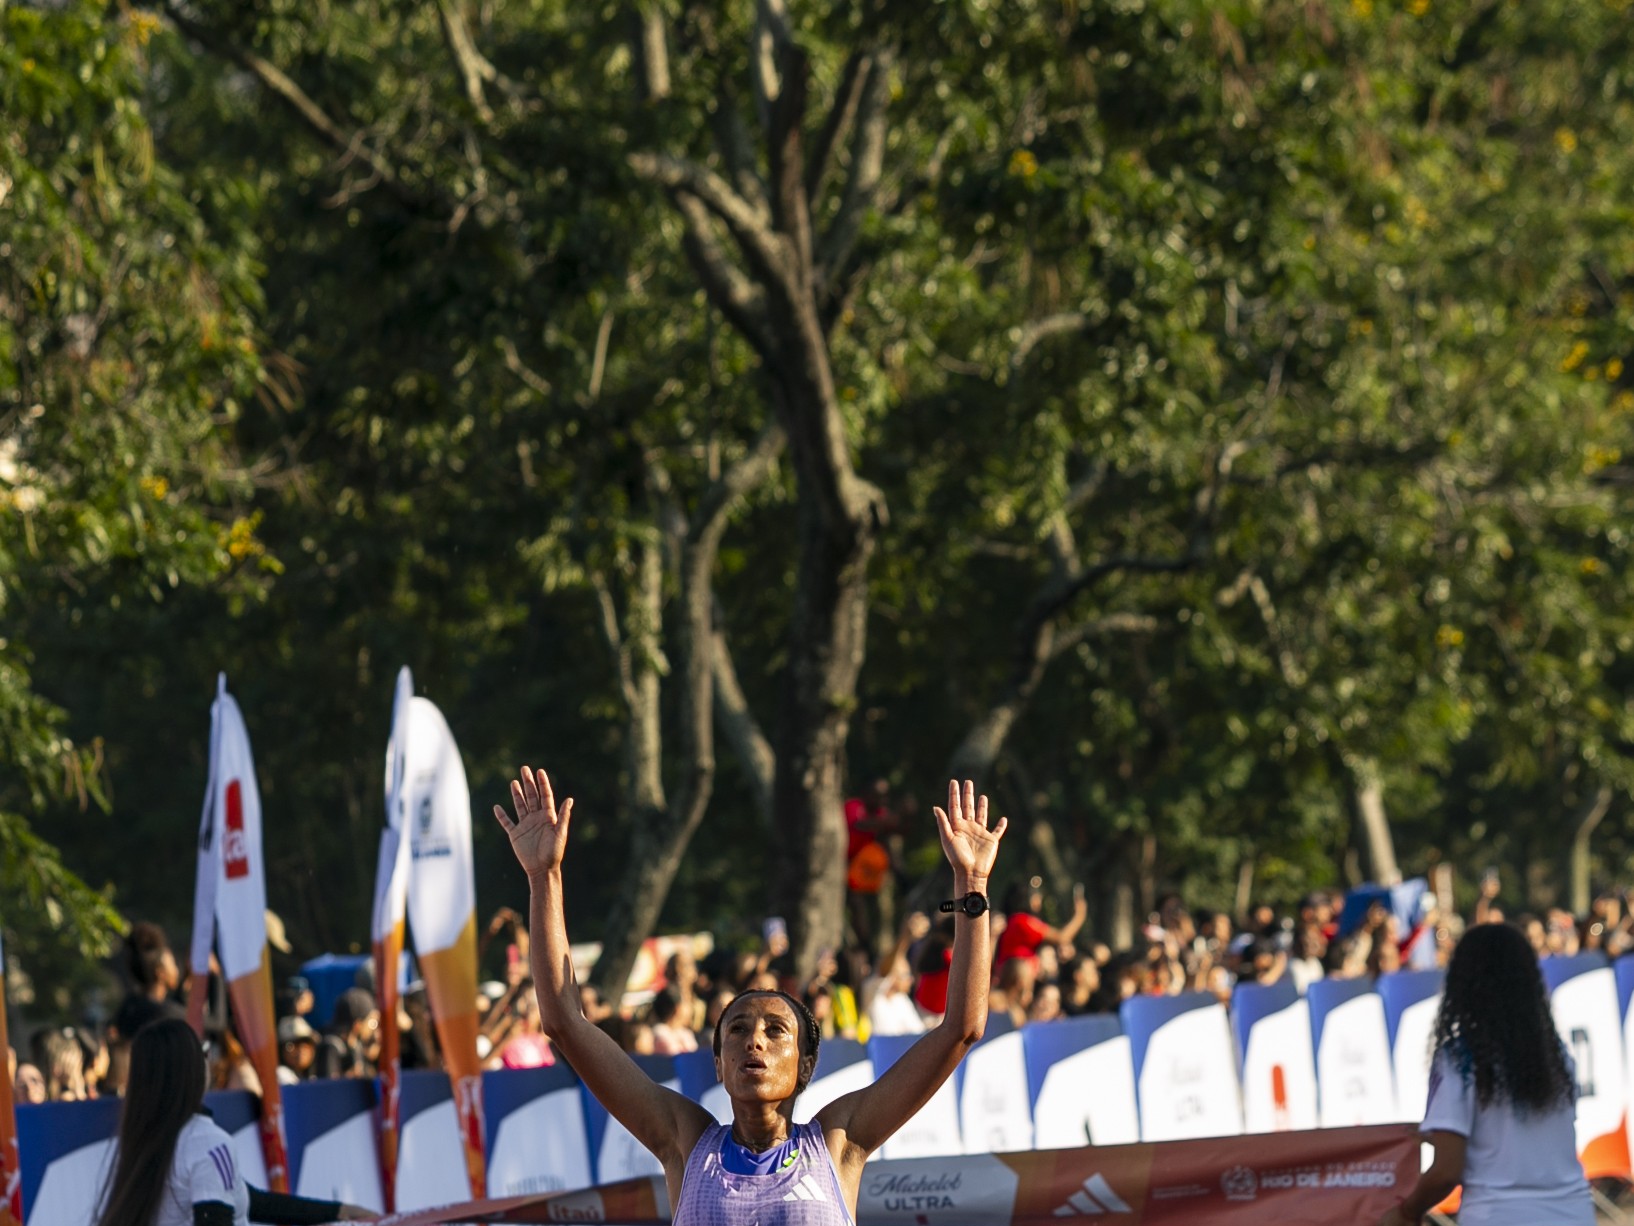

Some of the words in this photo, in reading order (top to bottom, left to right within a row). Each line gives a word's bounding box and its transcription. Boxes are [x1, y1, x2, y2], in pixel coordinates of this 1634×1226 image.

[868, 1172, 963, 1198] Michelob
[1261, 1174, 1294, 1188] RIO
[1296, 1172, 1320, 1188] DE
[1323, 1171, 1396, 1188] JANEIRO
[885, 1195, 956, 1212] ULTRA
[553, 1204, 600, 1221] itaú
